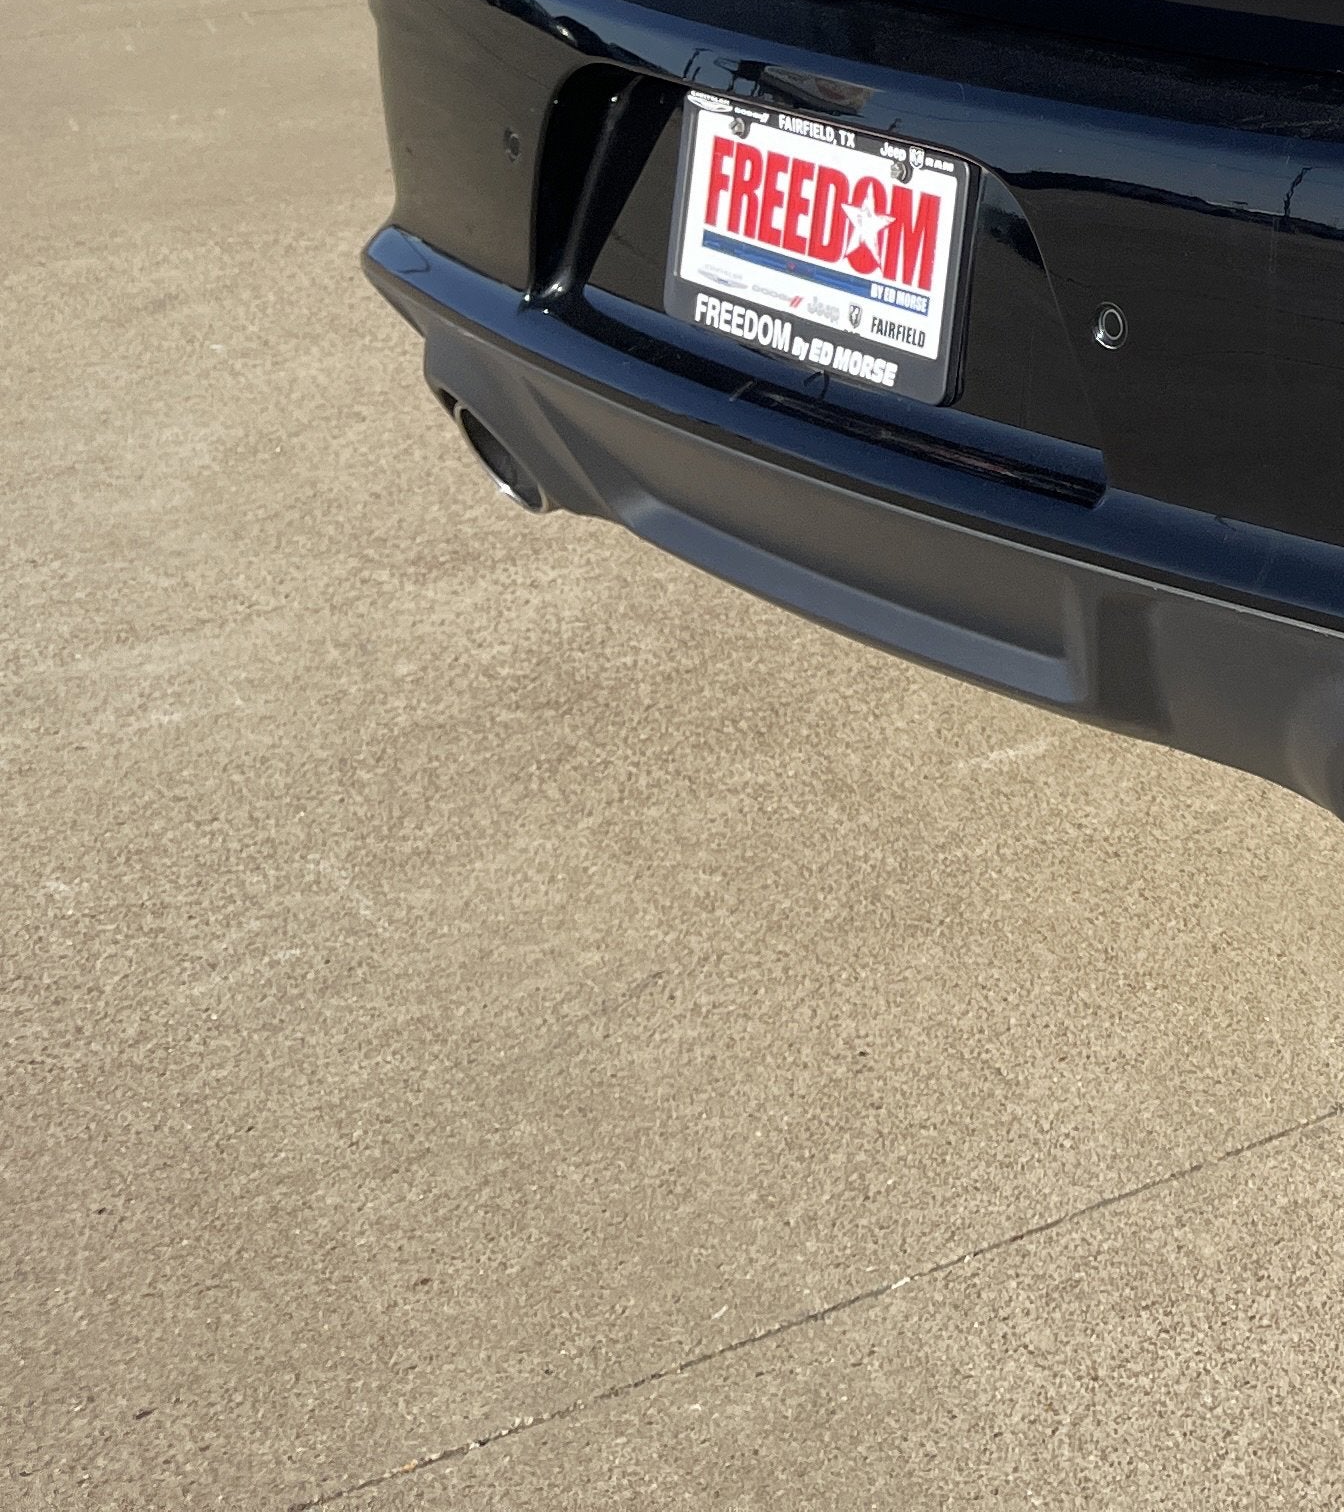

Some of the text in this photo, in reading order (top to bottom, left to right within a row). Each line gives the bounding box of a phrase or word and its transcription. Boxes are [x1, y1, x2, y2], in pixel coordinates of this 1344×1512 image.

[778, 114, 856, 148] FAIRFIELD, TX
[880, 141, 907, 162] Jeep
[703, 134, 942, 292] FREEDOM
[896, 289, 928, 314] MORSE
[694, 292, 899, 388] FREEDOM by ED MORSE
[870, 315, 926, 349] FAIRFIELD
